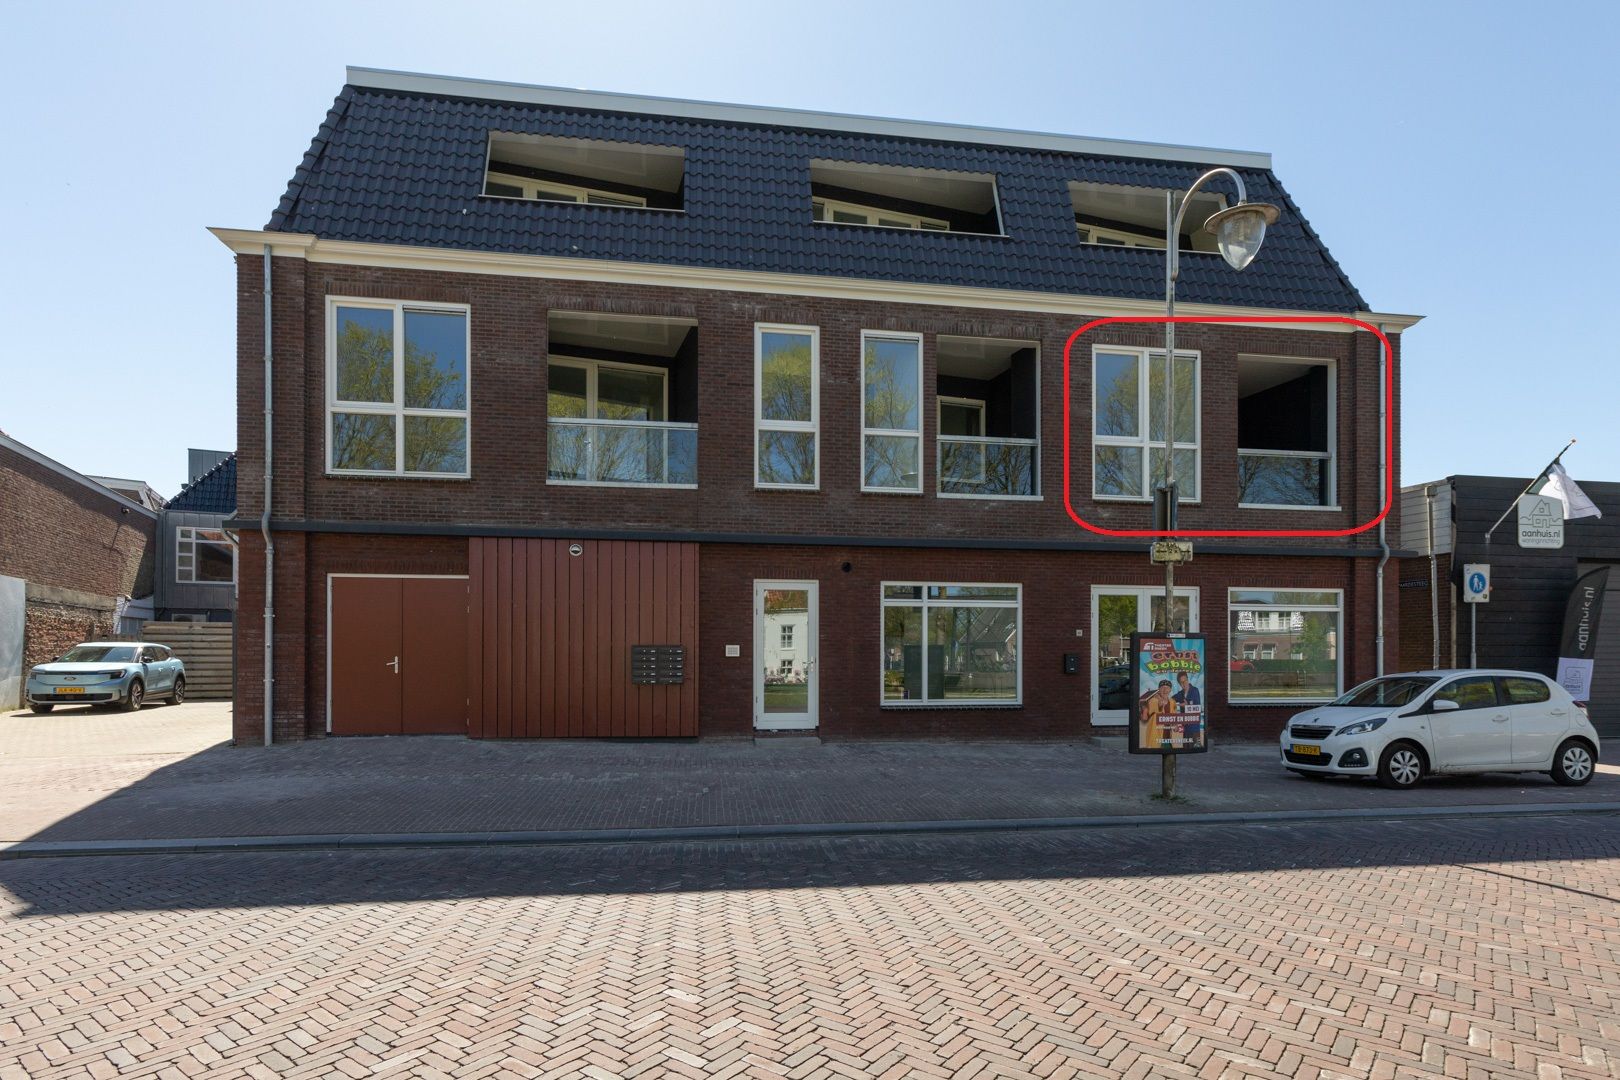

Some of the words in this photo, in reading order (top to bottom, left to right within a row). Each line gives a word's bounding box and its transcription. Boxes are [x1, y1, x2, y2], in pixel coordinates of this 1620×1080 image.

[1522, 529, 1560, 538] aanhuis.nl
[1578, 586, 1595, 651] aanhuis.nl
[1148, 660, 1200, 671] bobbie
